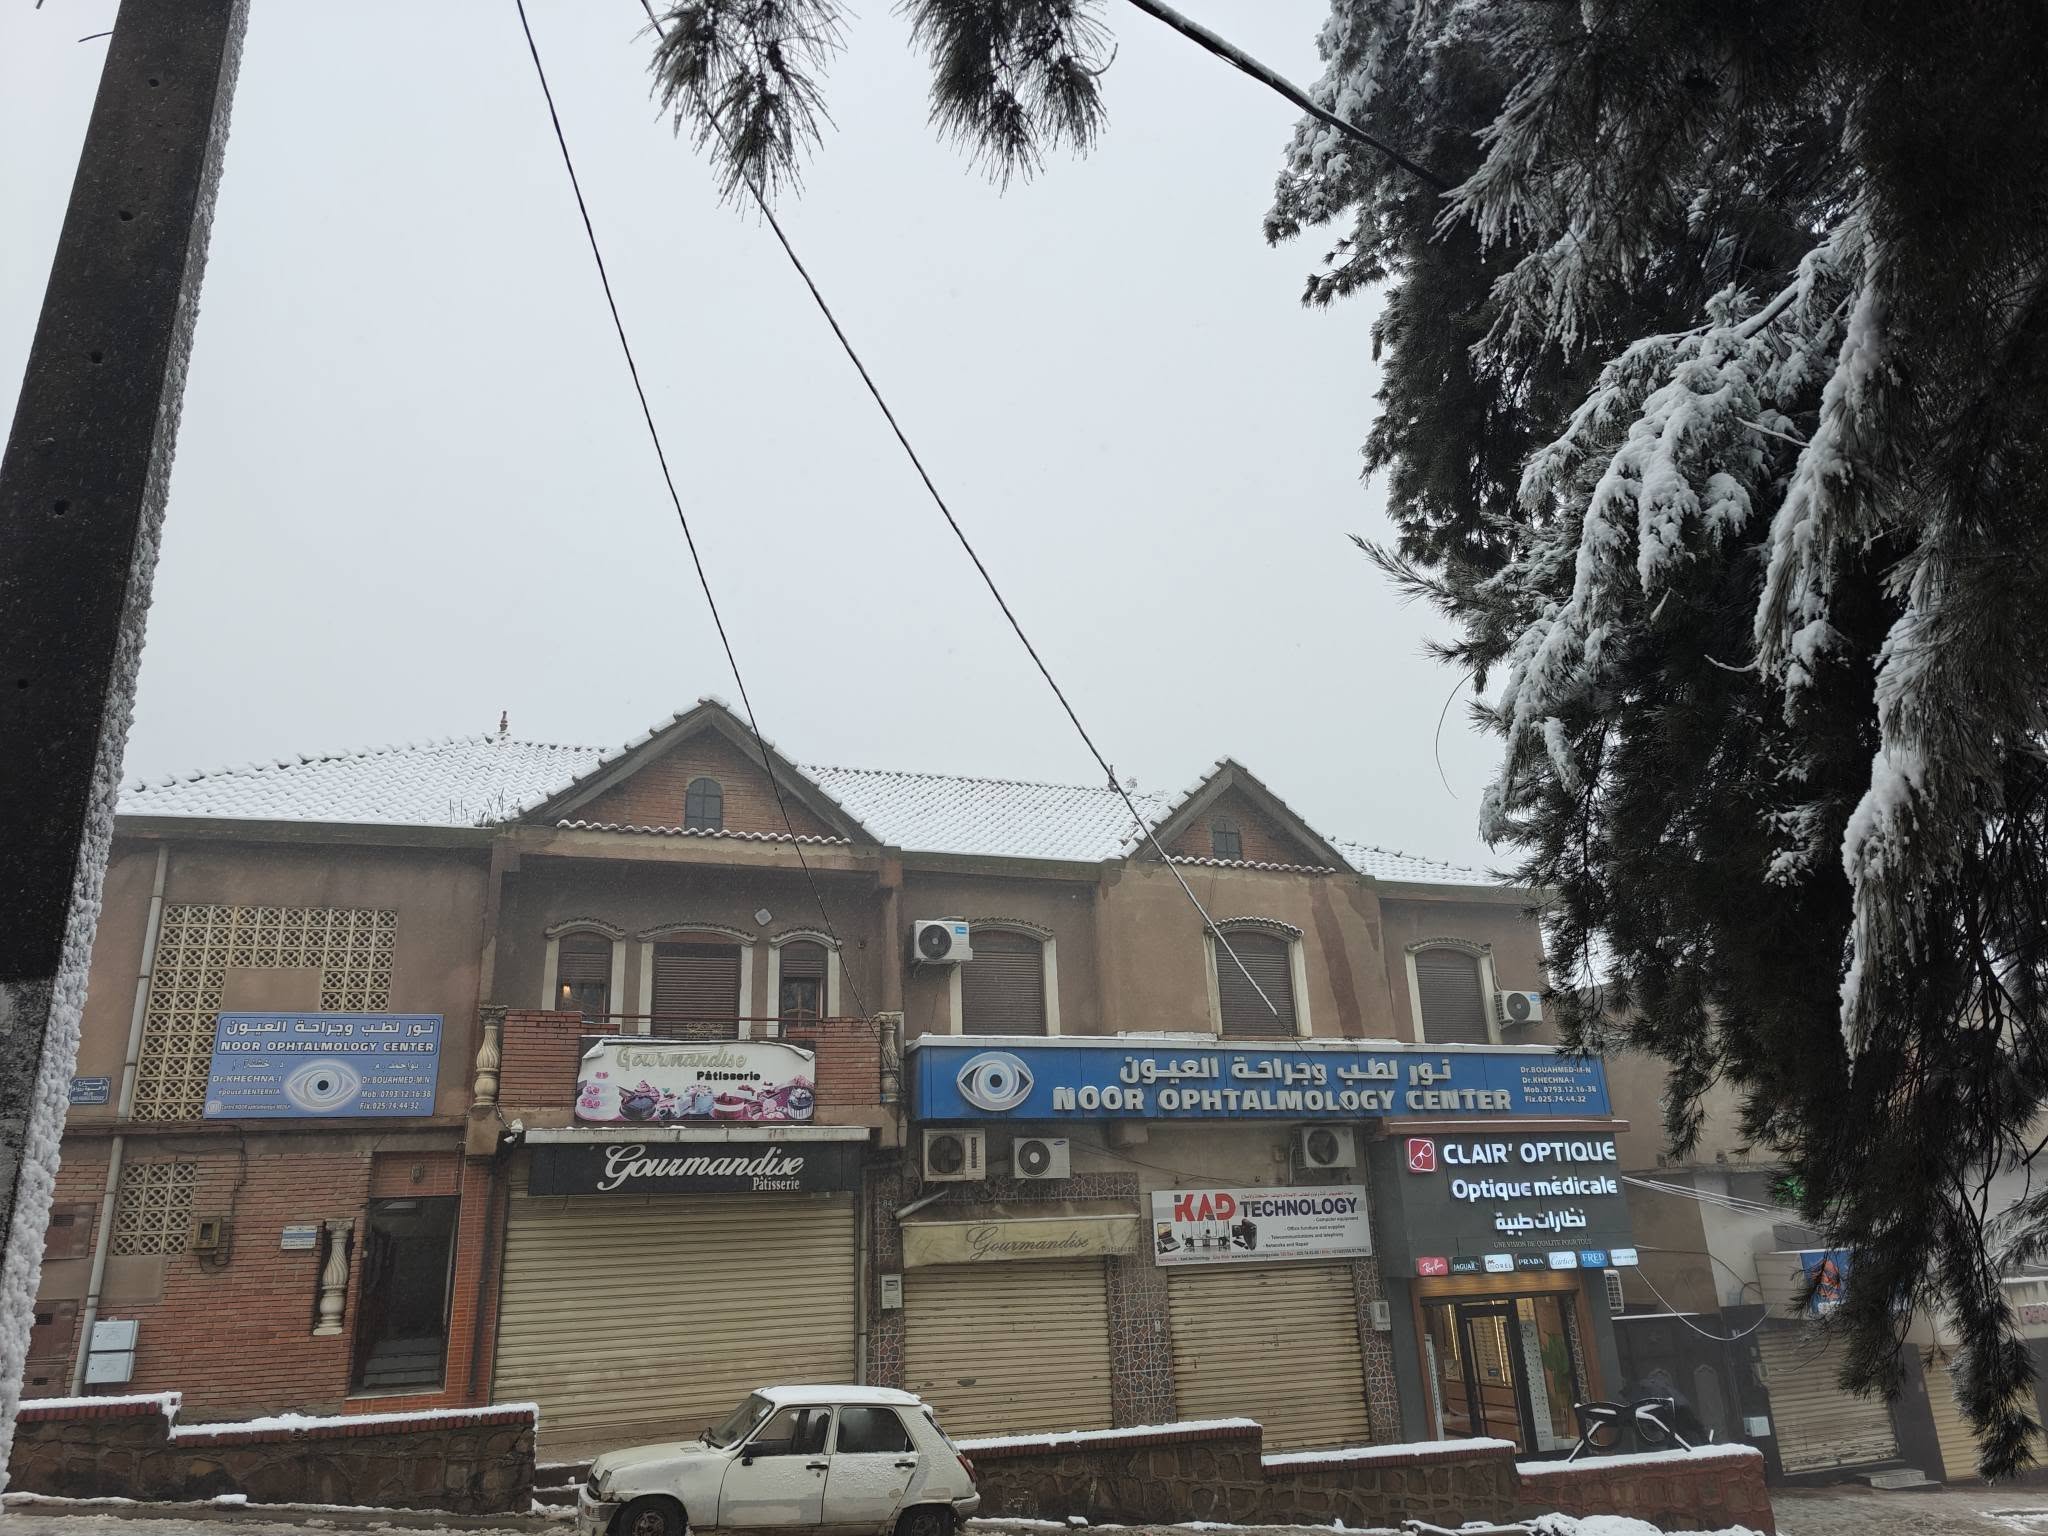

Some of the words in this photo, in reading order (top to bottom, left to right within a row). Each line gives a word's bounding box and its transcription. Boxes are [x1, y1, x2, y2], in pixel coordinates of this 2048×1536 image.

[226, 1020, 287, 1036] العيون
[294, 1020, 354, 1036] وجراحة
[361, 1021, 400, 1036] لطب
[406, 1020, 435, 1037] نور
[220, 1041, 261, 1052] NOOR
[266, 1041, 377, 1052] OPHTALMOLOGY
[383, 1041, 434, 1052] CENTER
[615, 1044, 748, 1072] Gourmandise
[696, 1070, 761, 1082] Pâtisserie
[1119, 1056, 1220, 1085] العيون
[1231, 1055, 1328, 1086] وجراحة
[1336, 1057, 1399, 1086] لطب
[1408, 1058, 1452, 1086] نور
[1052, 1085, 1146, 1110] NOOR
[1157, 1087, 1395, 1111] OPHTALMOLOGY
[1405, 1088, 1512, 1111] CENTER
[1443, 1142, 1513, 1164] CLAIR'
[1520, 1140, 1617, 1164] OPTIQUE
[596, 1143, 804, 1191] Gourmandise
[752, 1175, 800, 1192] Pâtisserie
[1451, 1178, 1532, 1203] Optique
[1533, 1175, 1618, 1197] médicale
[1173, 1193, 1237, 1222] KAD
[1239, 1197, 1358, 1218] TECHNOLOGY
[1534, 1206, 1587, 1233] نظارات
[1495, 1211, 1535, 1236] طبية
[965, 1225, 1089, 1261] Gourmandise
[1518, 1257, 1544, 1266] PRADA
[1582, 1253, 1605, 1264] FRED
